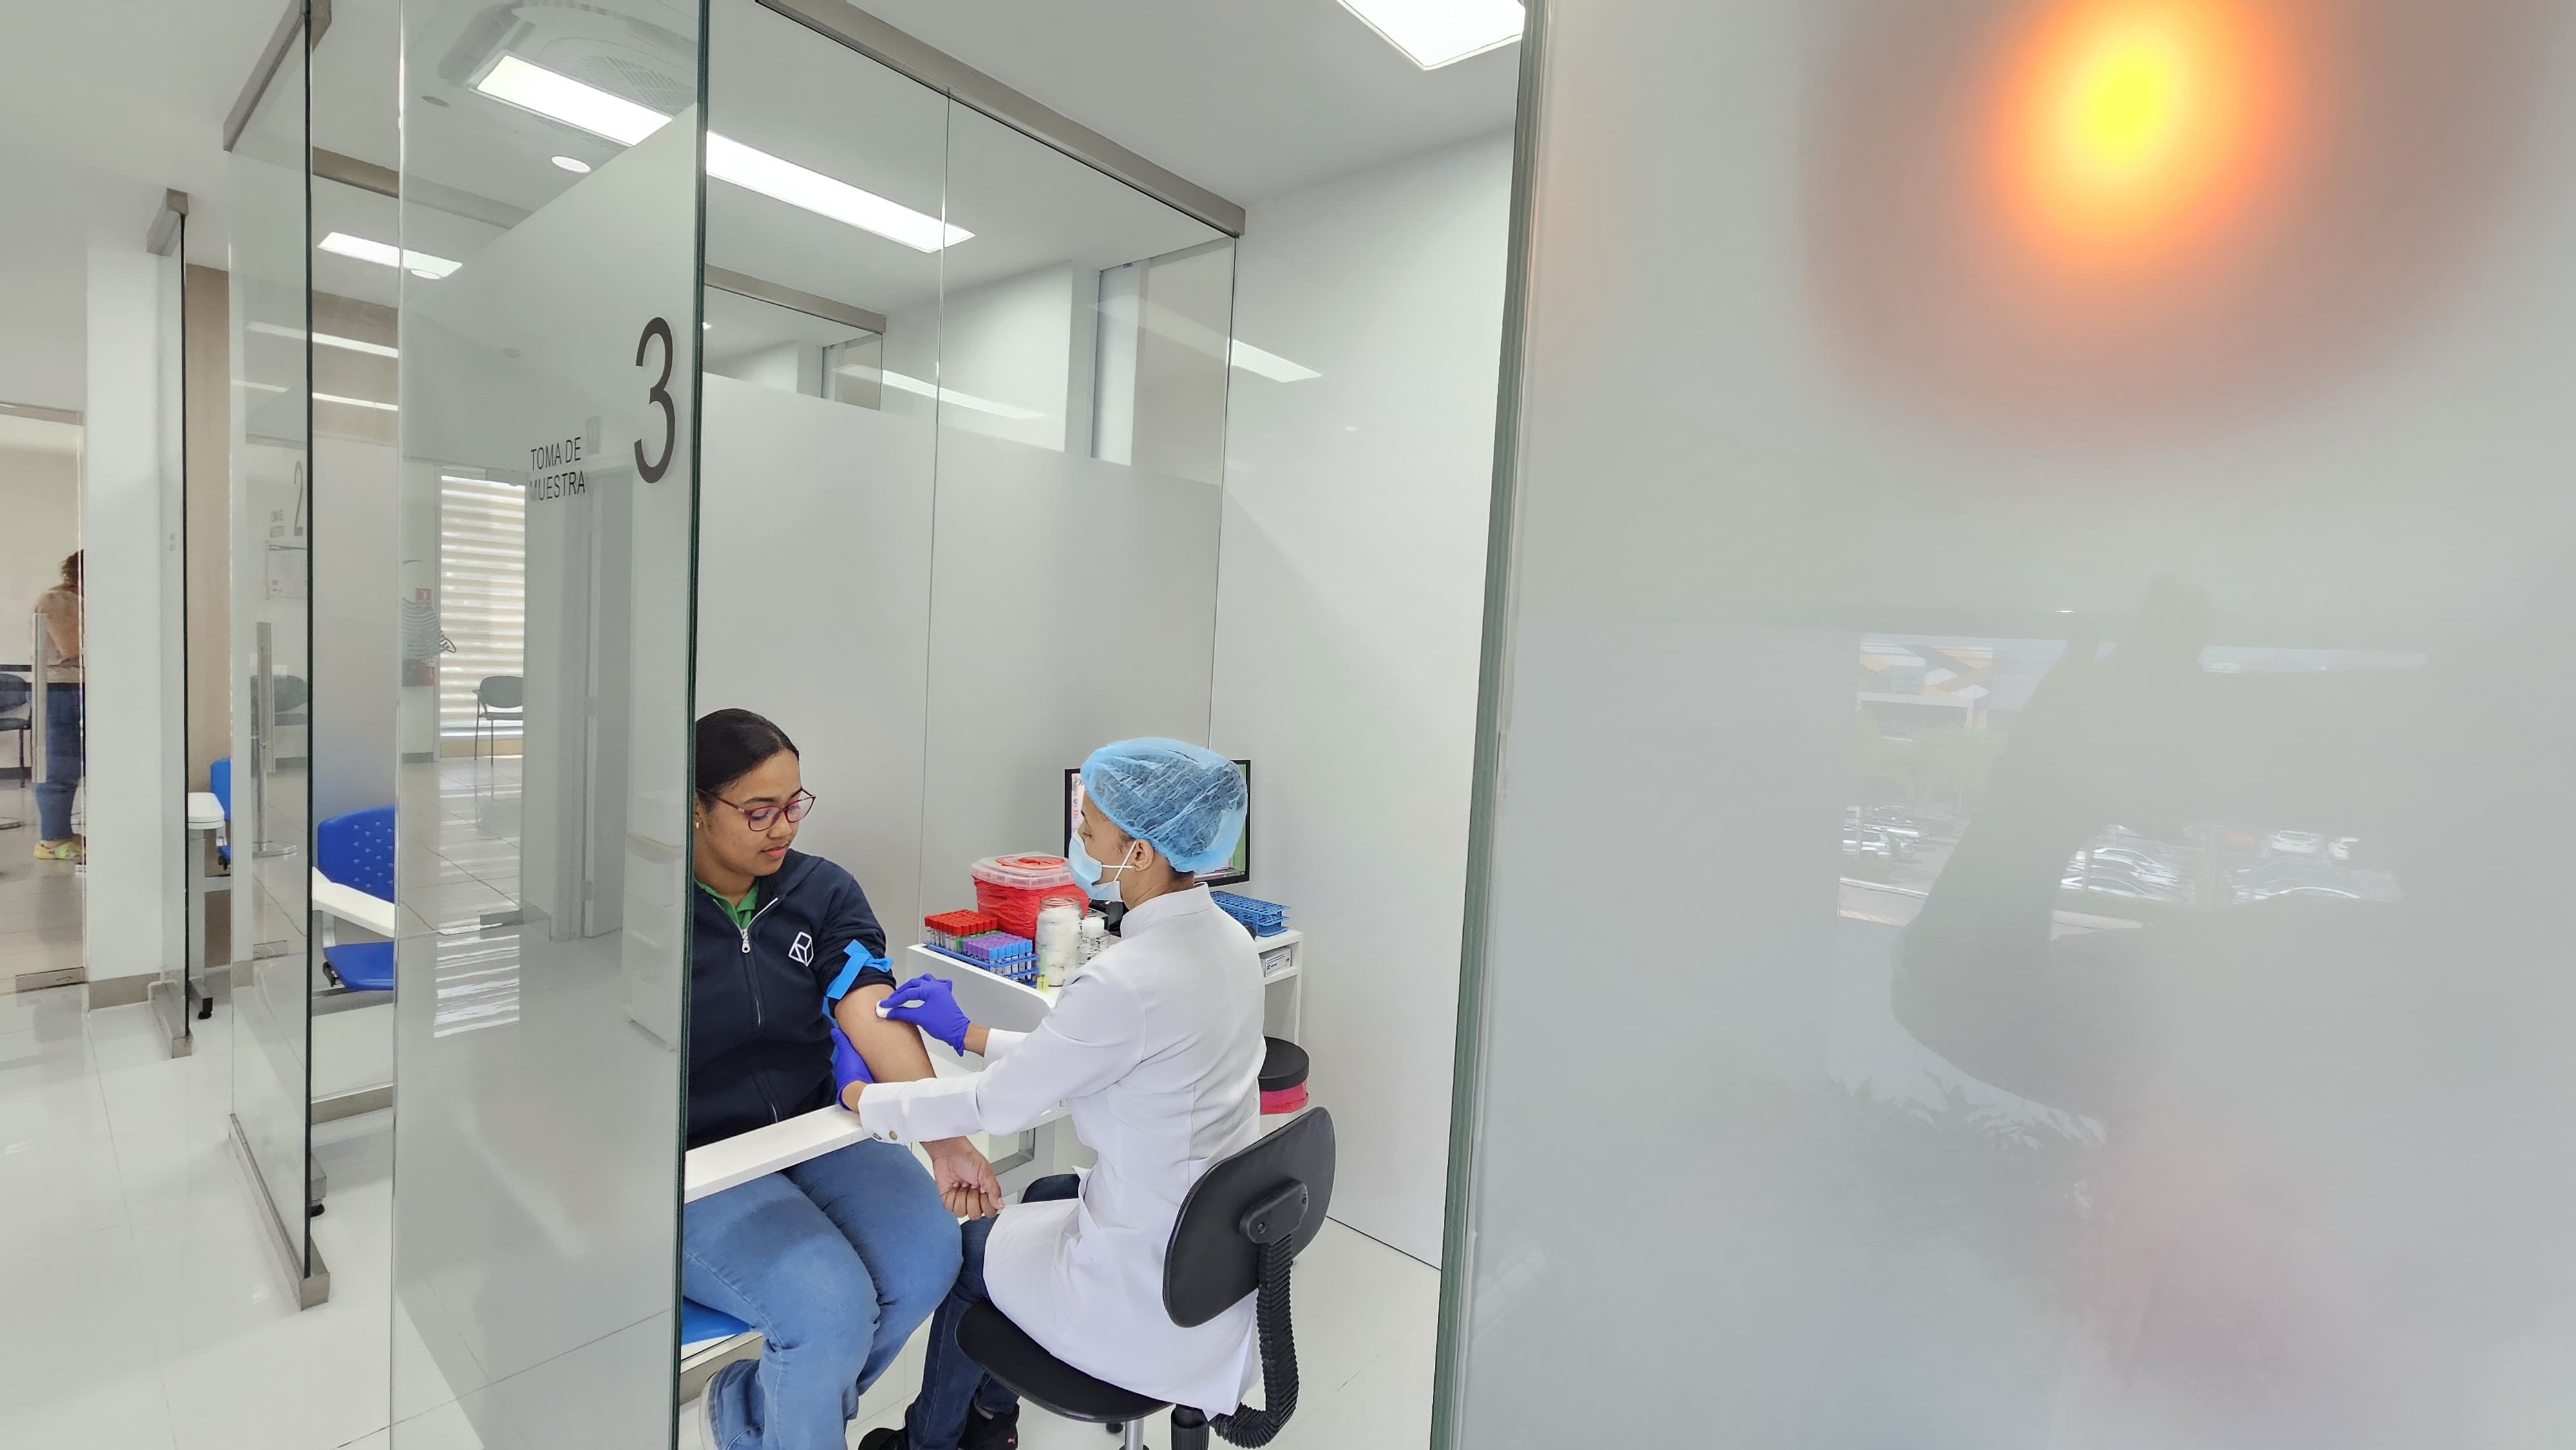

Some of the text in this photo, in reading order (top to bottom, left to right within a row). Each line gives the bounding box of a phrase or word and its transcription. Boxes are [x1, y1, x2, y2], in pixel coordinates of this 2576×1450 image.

[634, 317, 675, 484] 3
[531, 437, 581, 471] TOMA DE
[294, 460, 303, 536] 2
